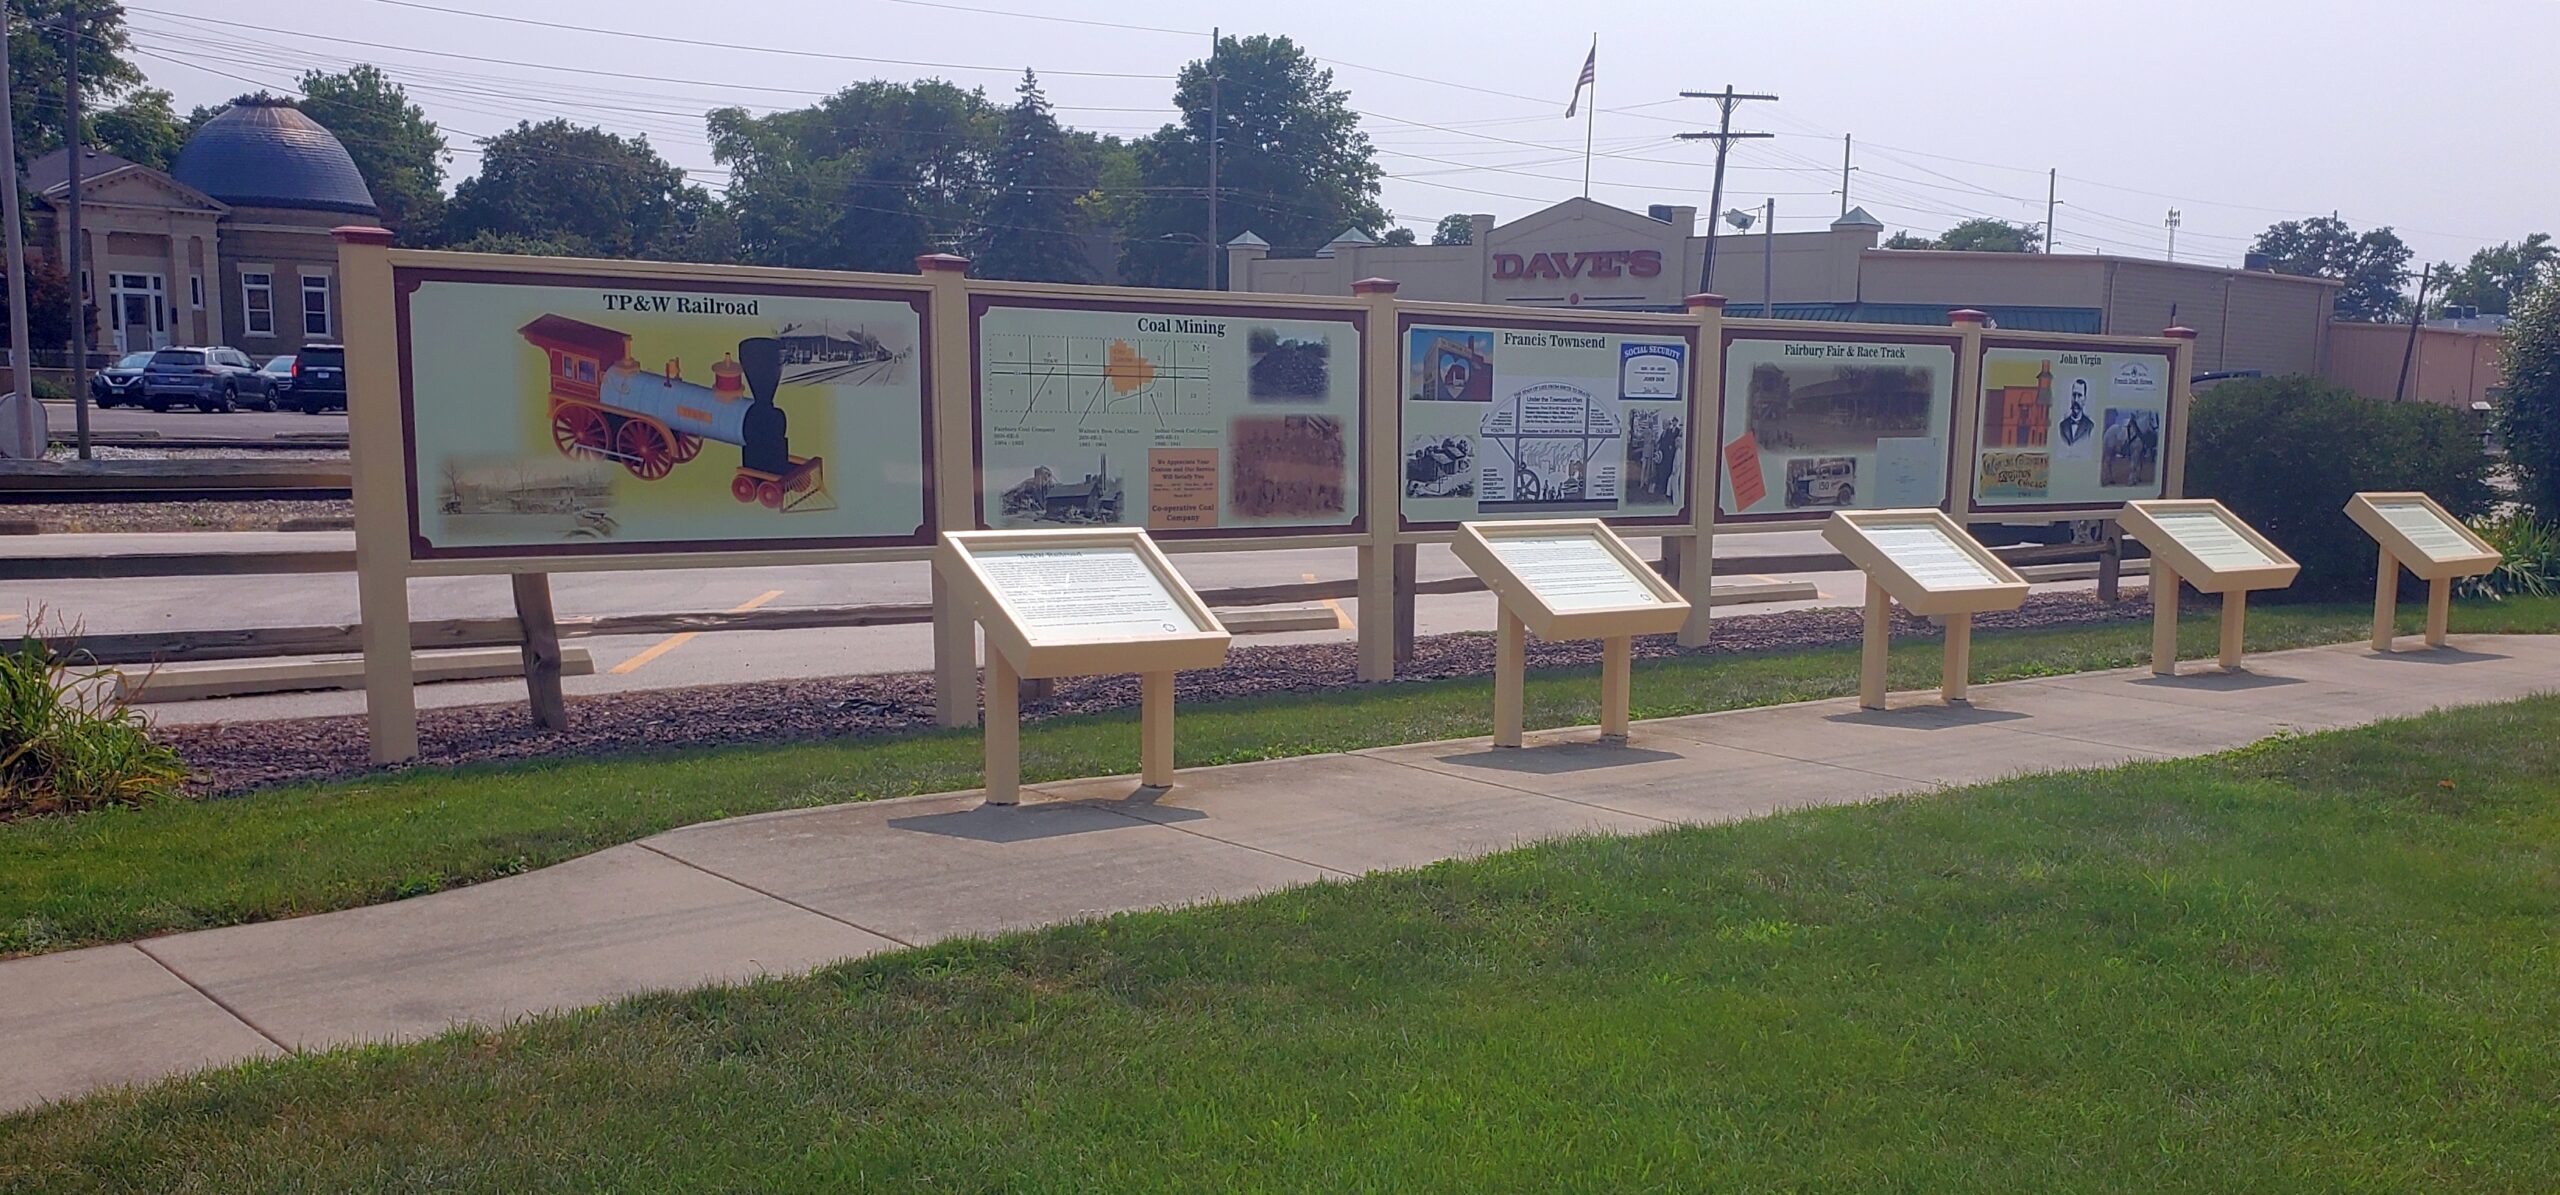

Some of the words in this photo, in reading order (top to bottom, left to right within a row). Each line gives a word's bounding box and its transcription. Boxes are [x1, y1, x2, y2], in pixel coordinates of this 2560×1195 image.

[1492, 250, 1662, 280] DAVE'S
[602, 294, 671, 312] TP&W
[676, 297, 759, 315] Railroad
[1137, 317, 1171, 332] Coal
[1175, 319, 1226, 338] Mining
[1504, 332, 1547, 346] Francis
[1549, 334, 1606, 349] Townsend
[1624, 346, 1648, 358] SOCIAL
[1649, 345, 1681, 360] SECURITY
[1784, 343, 1825, 358] Fairbury
[1826, 345, 1845, 357] Fair
[1846, 345, 1855, 357] &
[1857, 346, 1878, 358] Race
[1880, 346, 1906, 358] Track
[2060, 353, 2078, 365] John
[2080, 354, 2102, 367] Virgin
[1152, 504, 1197, 513] Co-operative
[1199, 503, 1215, 511] Coal
[1167, 514, 1200, 522] Company
